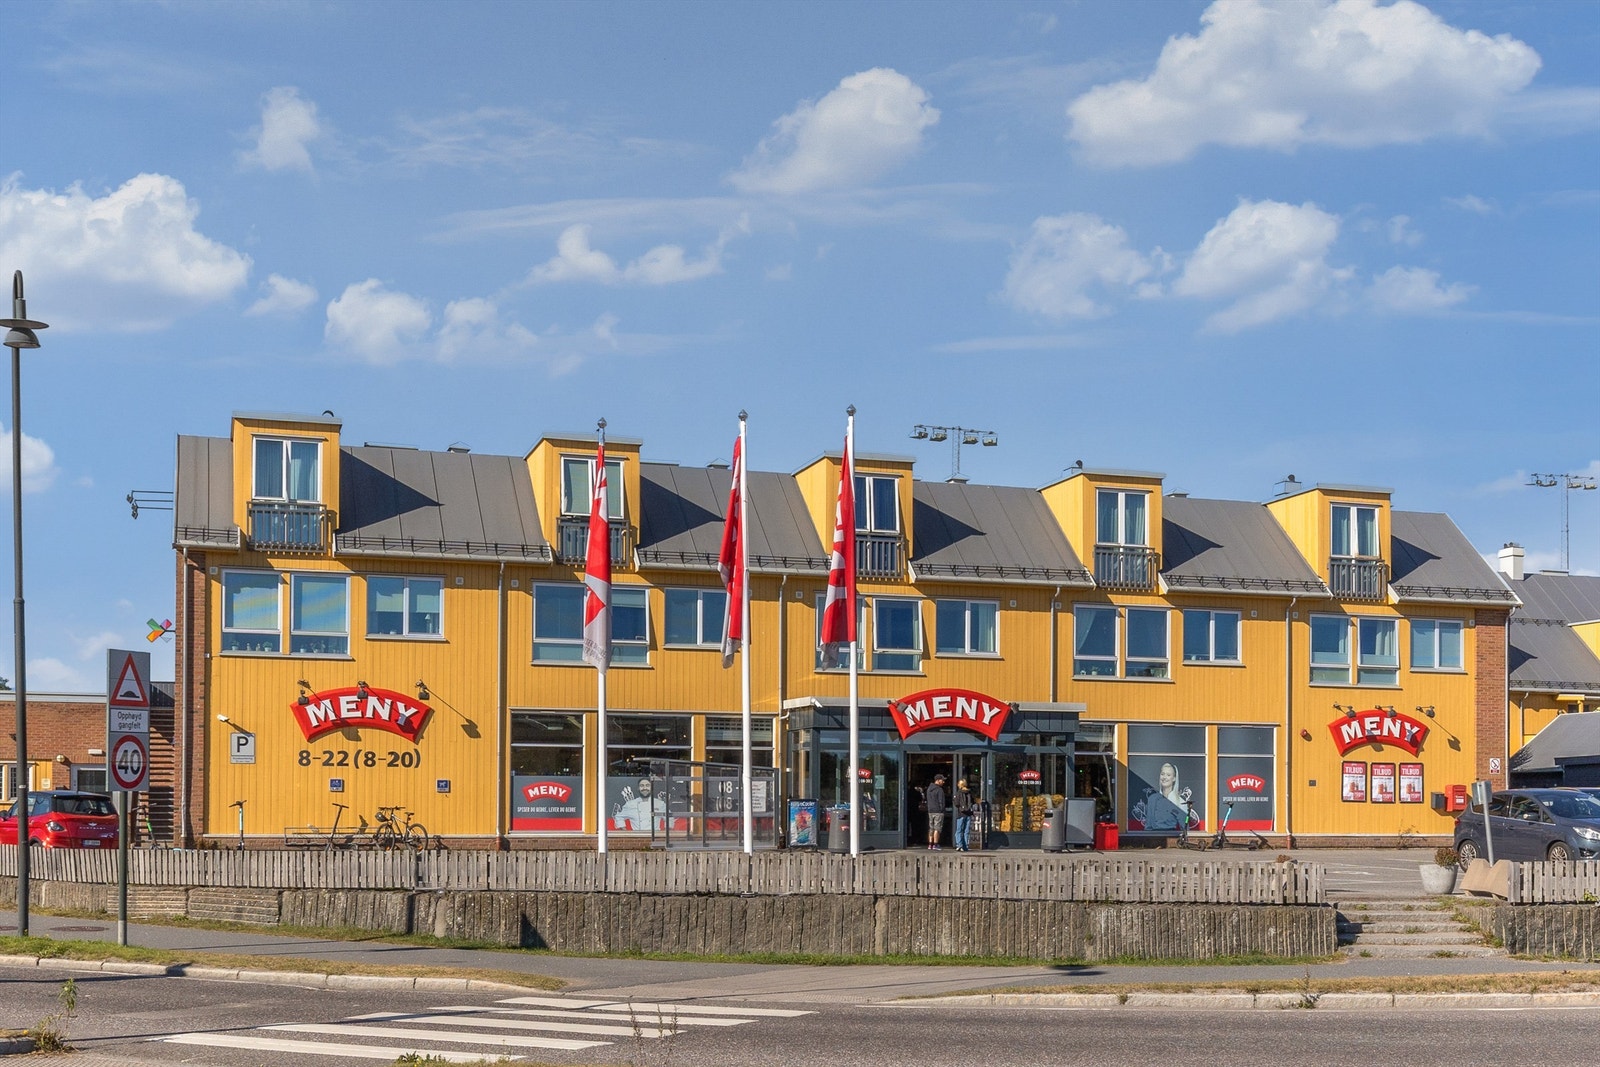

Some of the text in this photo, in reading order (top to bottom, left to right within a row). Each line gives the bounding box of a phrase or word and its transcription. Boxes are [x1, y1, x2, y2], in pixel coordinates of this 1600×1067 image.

[117, 711, 142, 722] Opphøyd
[305, 695, 419, 728] MENY
[904, 695, 1001, 727] MENY
[118, 721, 141, 730] gangfelt
[1340, 716, 1420, 744] MENY
[237, 736, 249, 752] P
[118, 749, 141, 775] 40
[1345, 766, 1363, 774] TILBUD
[1230, 777, 1262, 788] MENY
[527, 785, 567, 798] MENY
